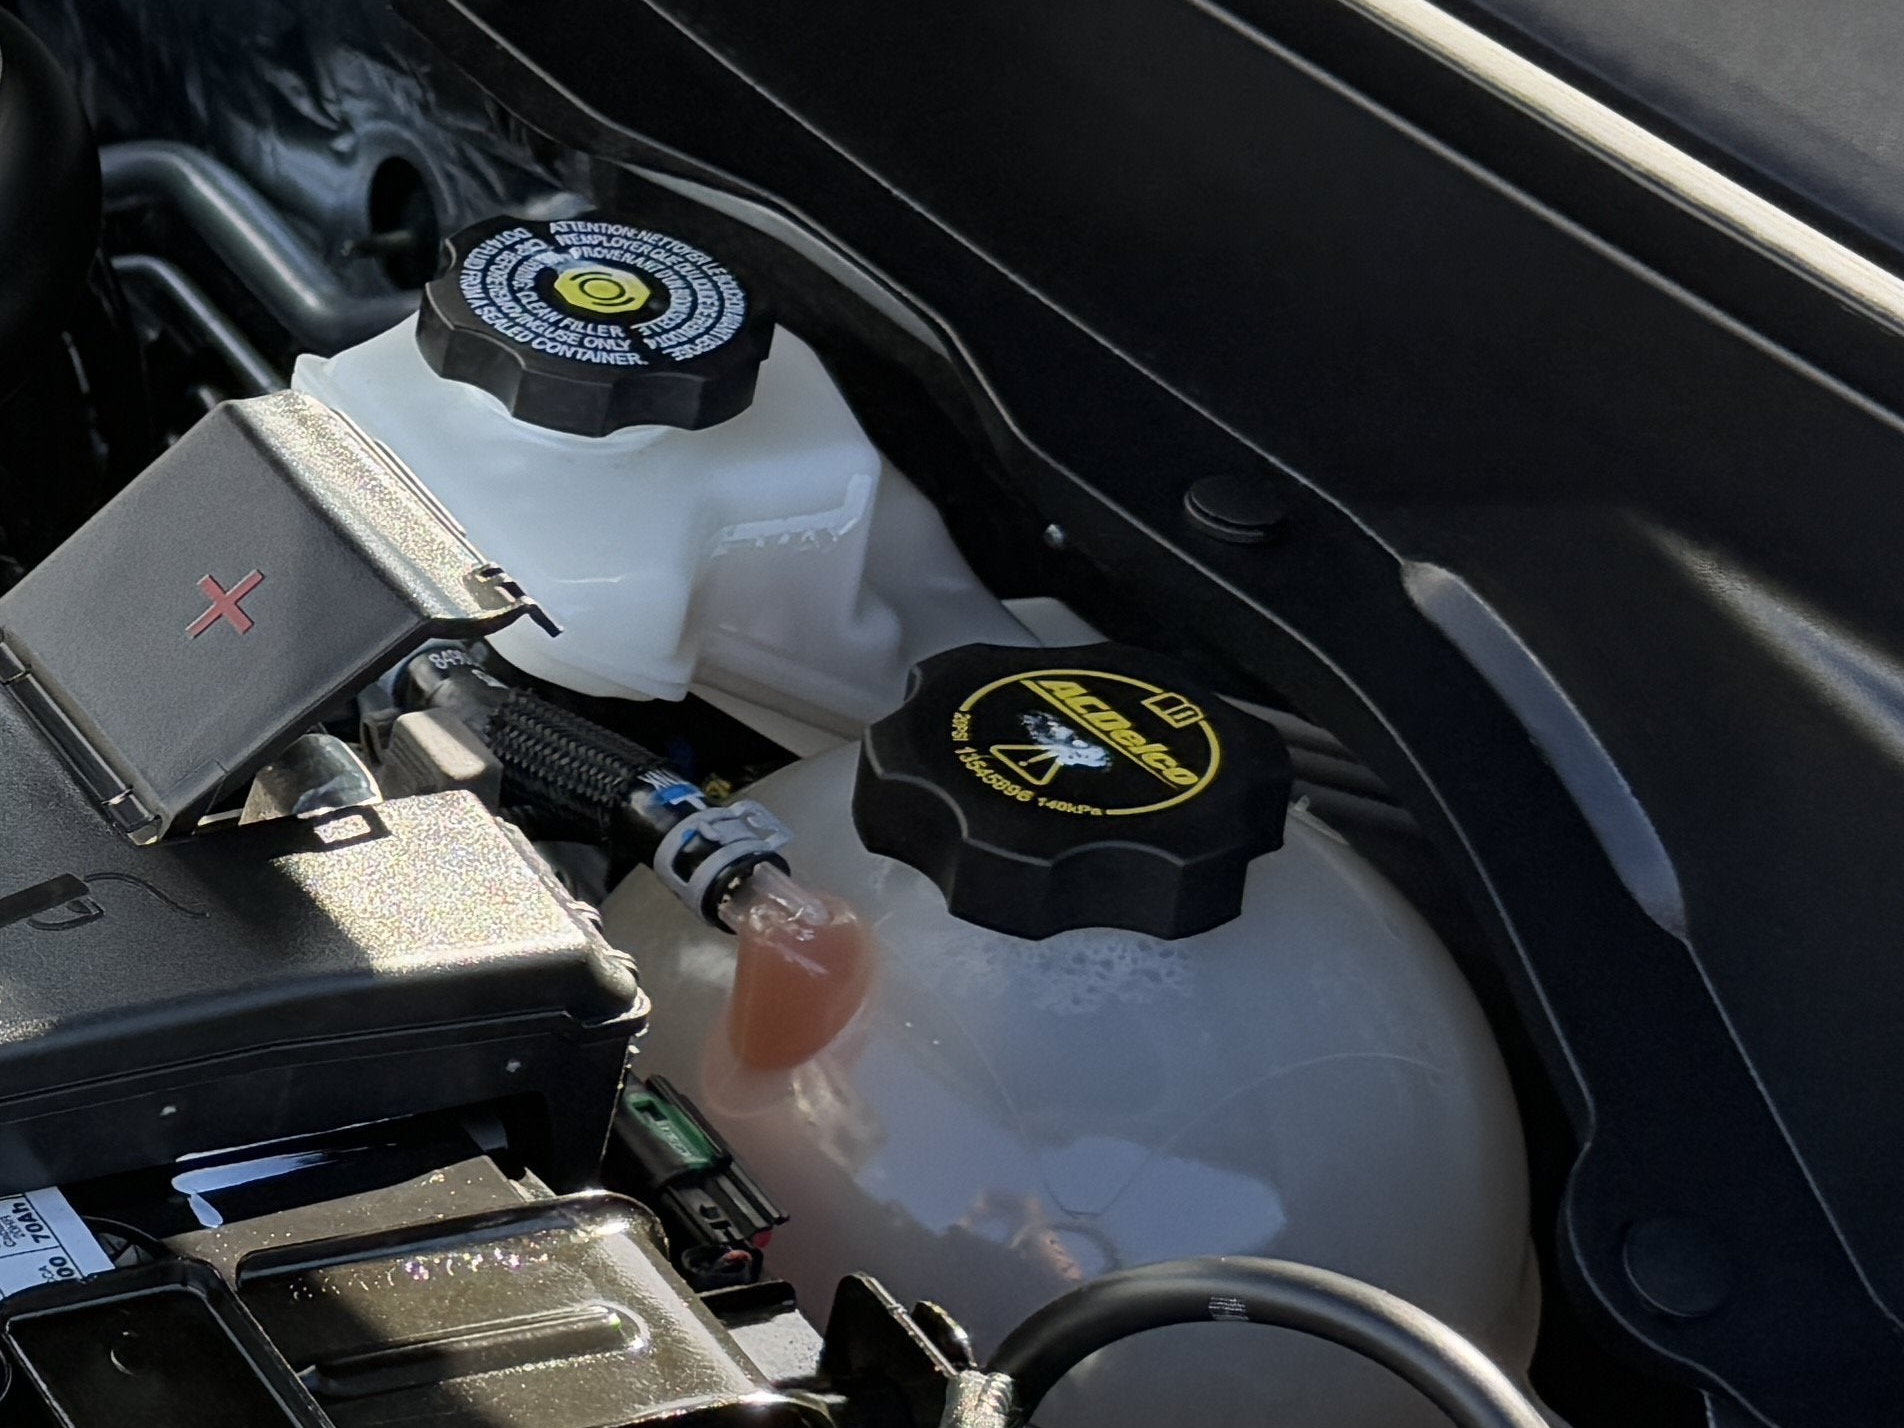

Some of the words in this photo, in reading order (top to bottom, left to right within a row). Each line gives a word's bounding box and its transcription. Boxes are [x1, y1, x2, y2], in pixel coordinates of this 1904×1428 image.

[473, 306, 535, 343] SEALED
[554, 316, 626, 339] FILLER
[580, 337, 637, 353] ONLY
[1037, 680, 1198, 786] ACDelco
[11, 1201, 52, 1244] 70Ah
